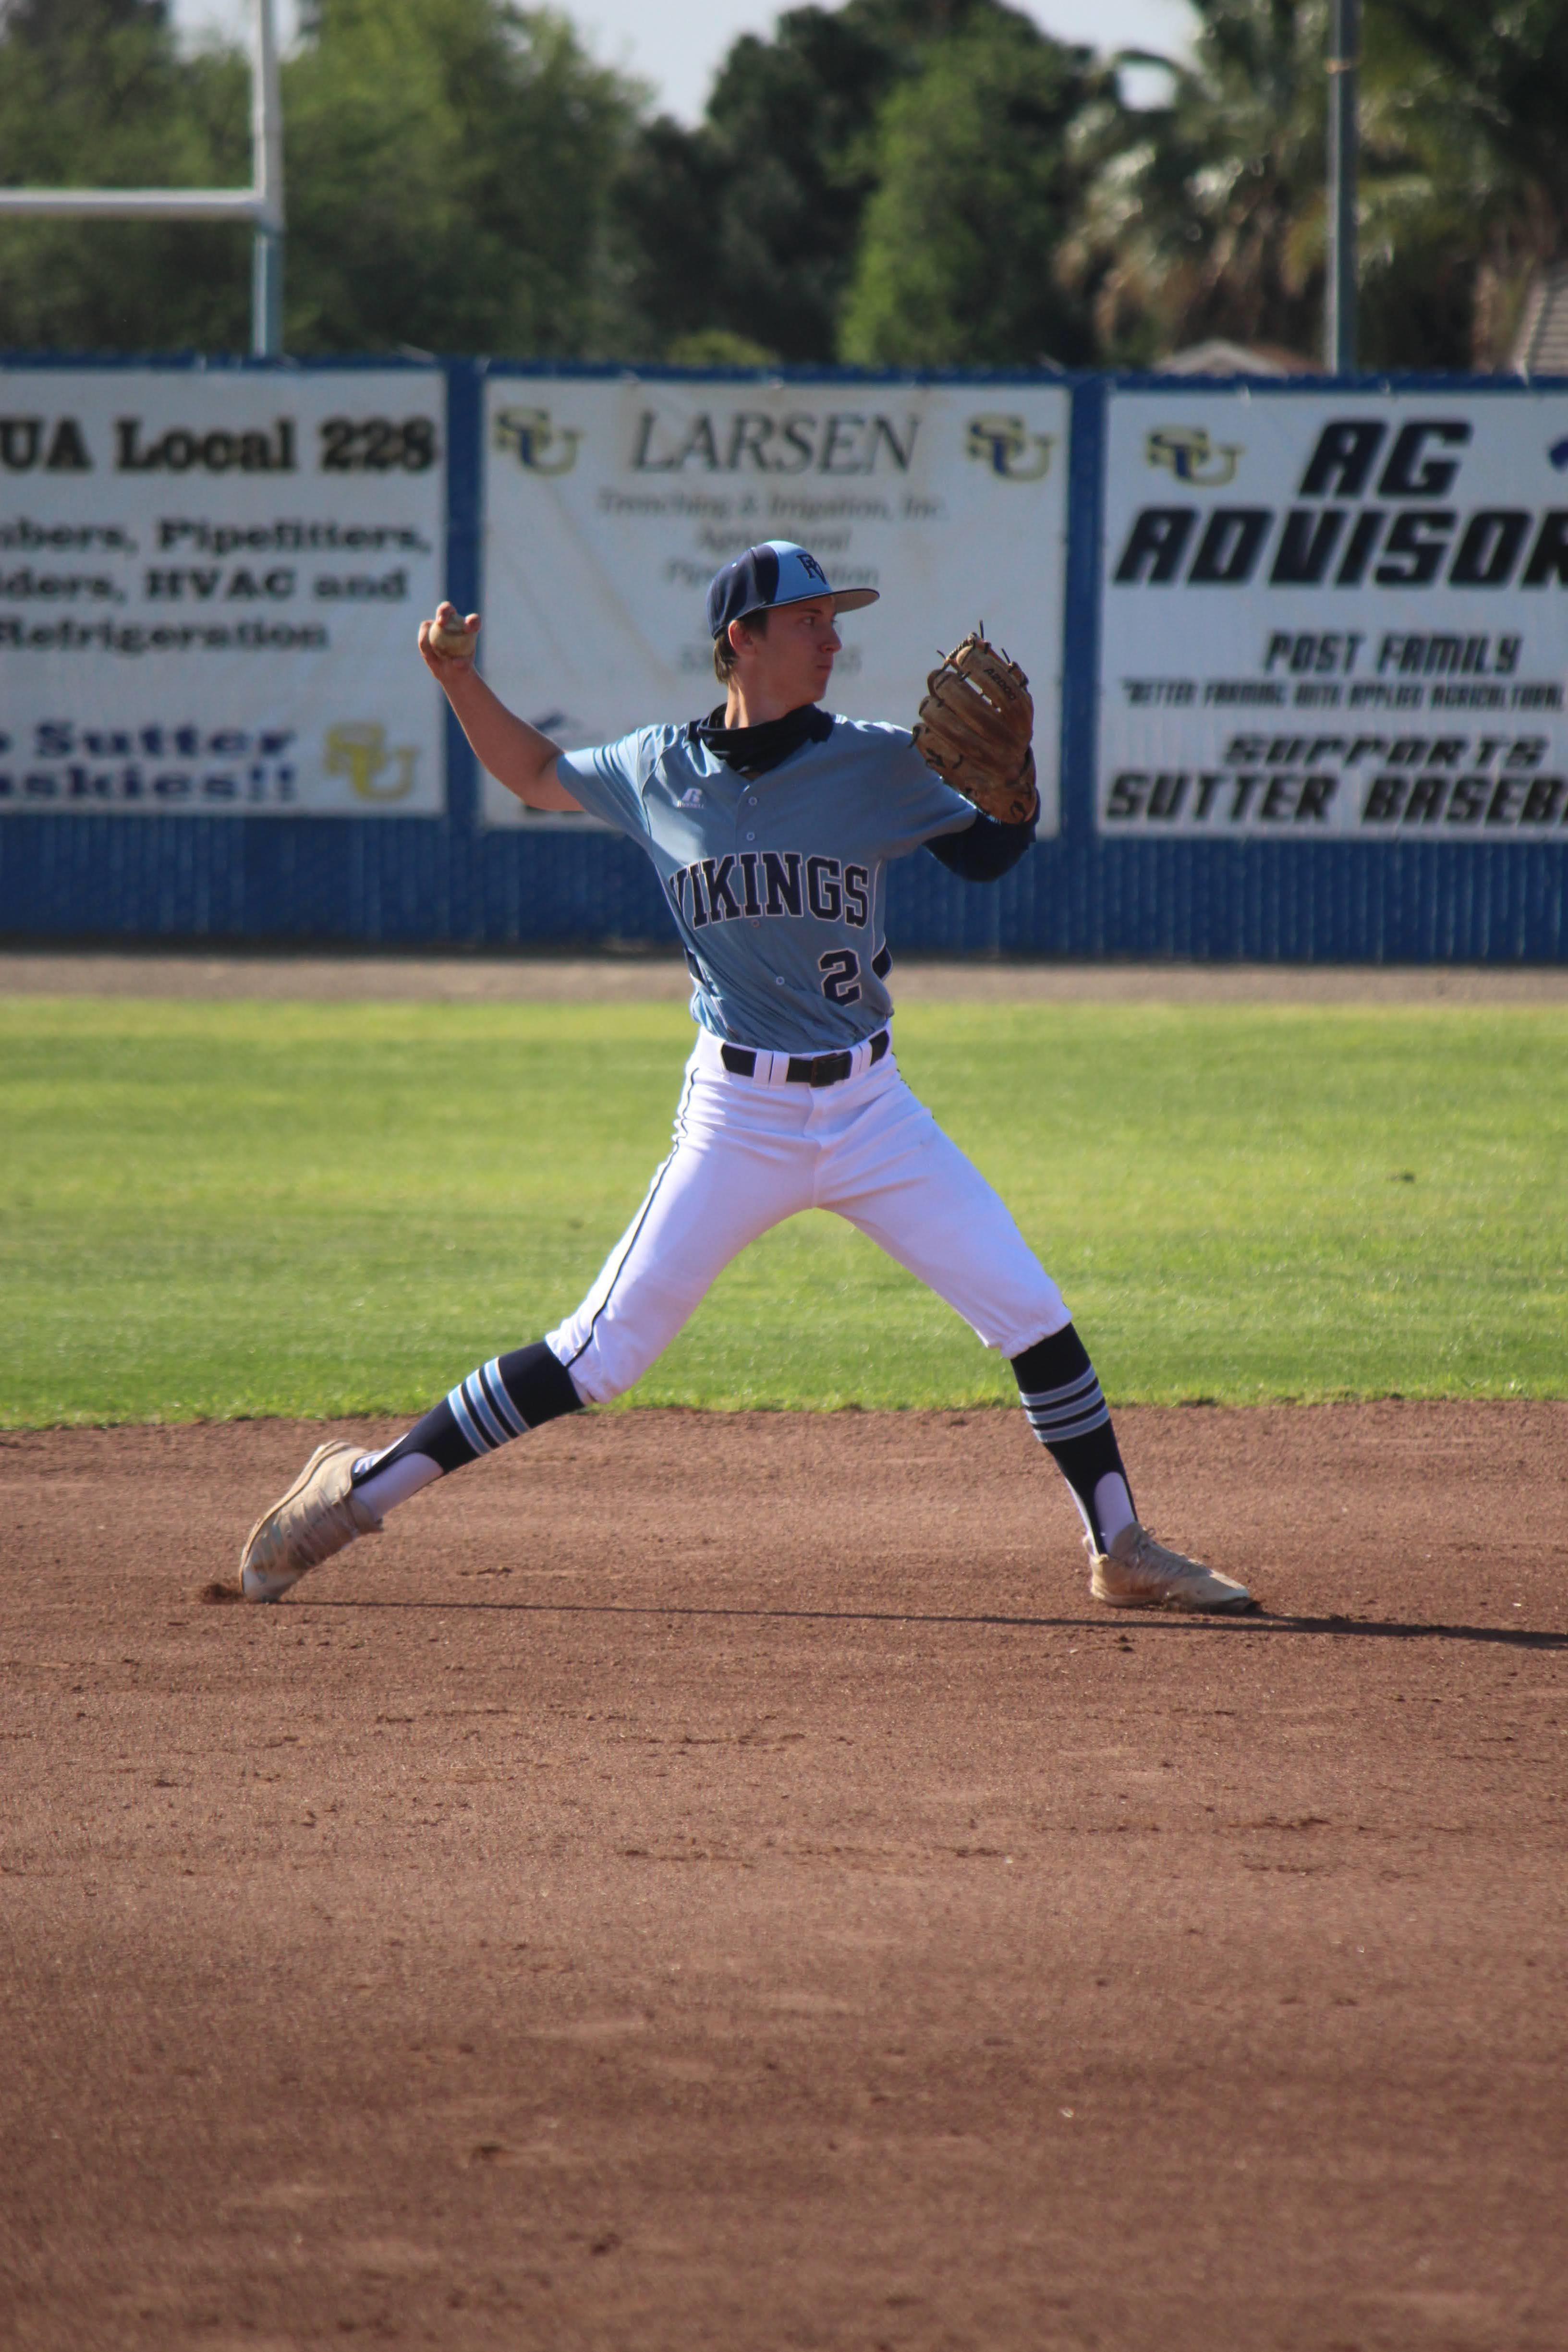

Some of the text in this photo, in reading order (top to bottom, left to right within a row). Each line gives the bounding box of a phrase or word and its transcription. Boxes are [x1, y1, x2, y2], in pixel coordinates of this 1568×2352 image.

[114, 417, 296, 473] Local
[319, 416, 436, 473] 228
[631, 410, 921, 475] LARSEN
[1298, 419, 1473, 499] AG
[156, 517, 431, 559] Pipefitters,
[145, 567, 295, 601] HVAC
[312, 567, 408, 602] and
[1263, 630, 1523, 676] POST FAMILY
[34, 720, 295, 757] Sutter
[1105, 772, 1568, 826] SUTTER BASEB
[669, 851, 869, 929] VIKINGS
[818, 948, 862, 1006] 2
